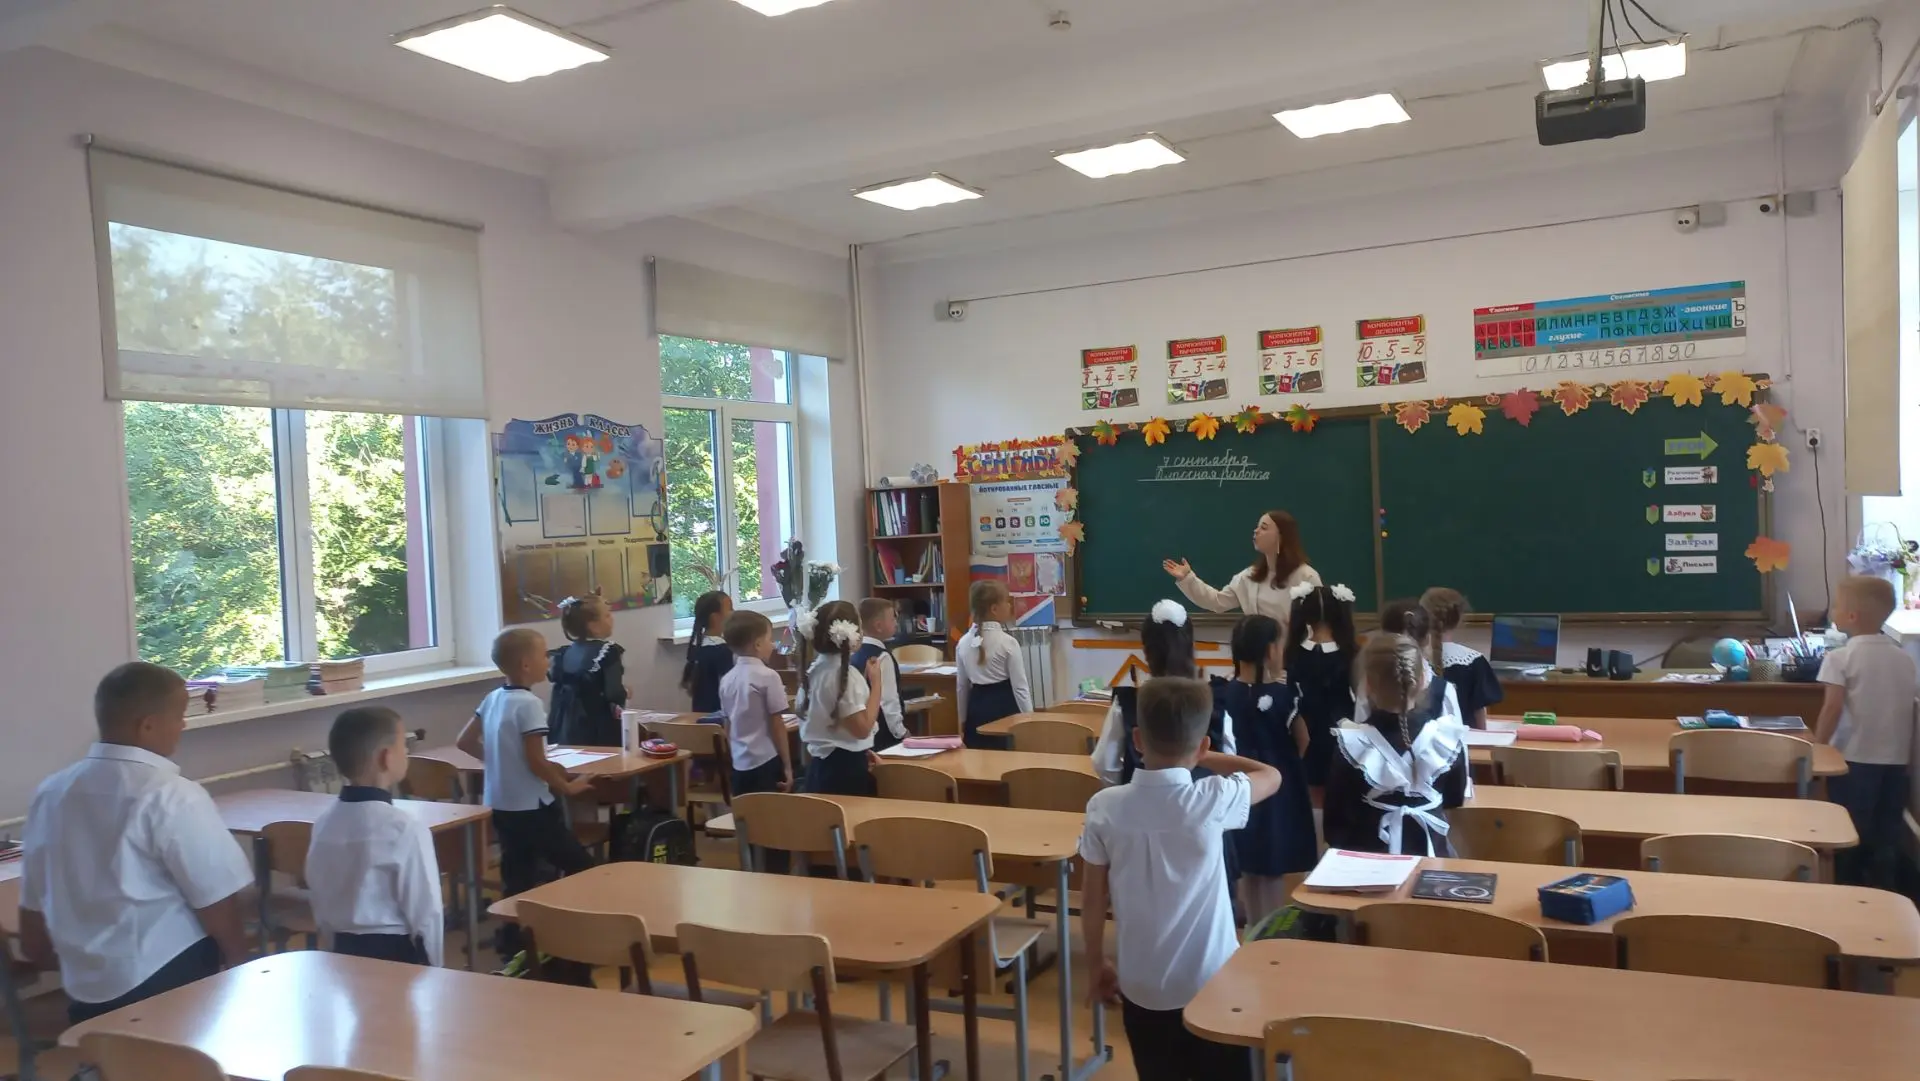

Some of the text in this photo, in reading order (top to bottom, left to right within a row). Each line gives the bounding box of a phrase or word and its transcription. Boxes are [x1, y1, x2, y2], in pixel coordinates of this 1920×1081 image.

[1386, 343, 1398, 357] 5
[1415, 341, 1425, 355] 2
[1193, 361, 1202, 374] 3
[1217, 359, 1226, 372] 4
[1263, 357, 1273, 371] 2
[1283, 355, 1292, 369] 3
[1310, 353, 1319, 366] 6
[534, 417, 631, 436] ЖИЗНЬ КЛАССА
[1668, 538, 1715, 548] Завтрак
